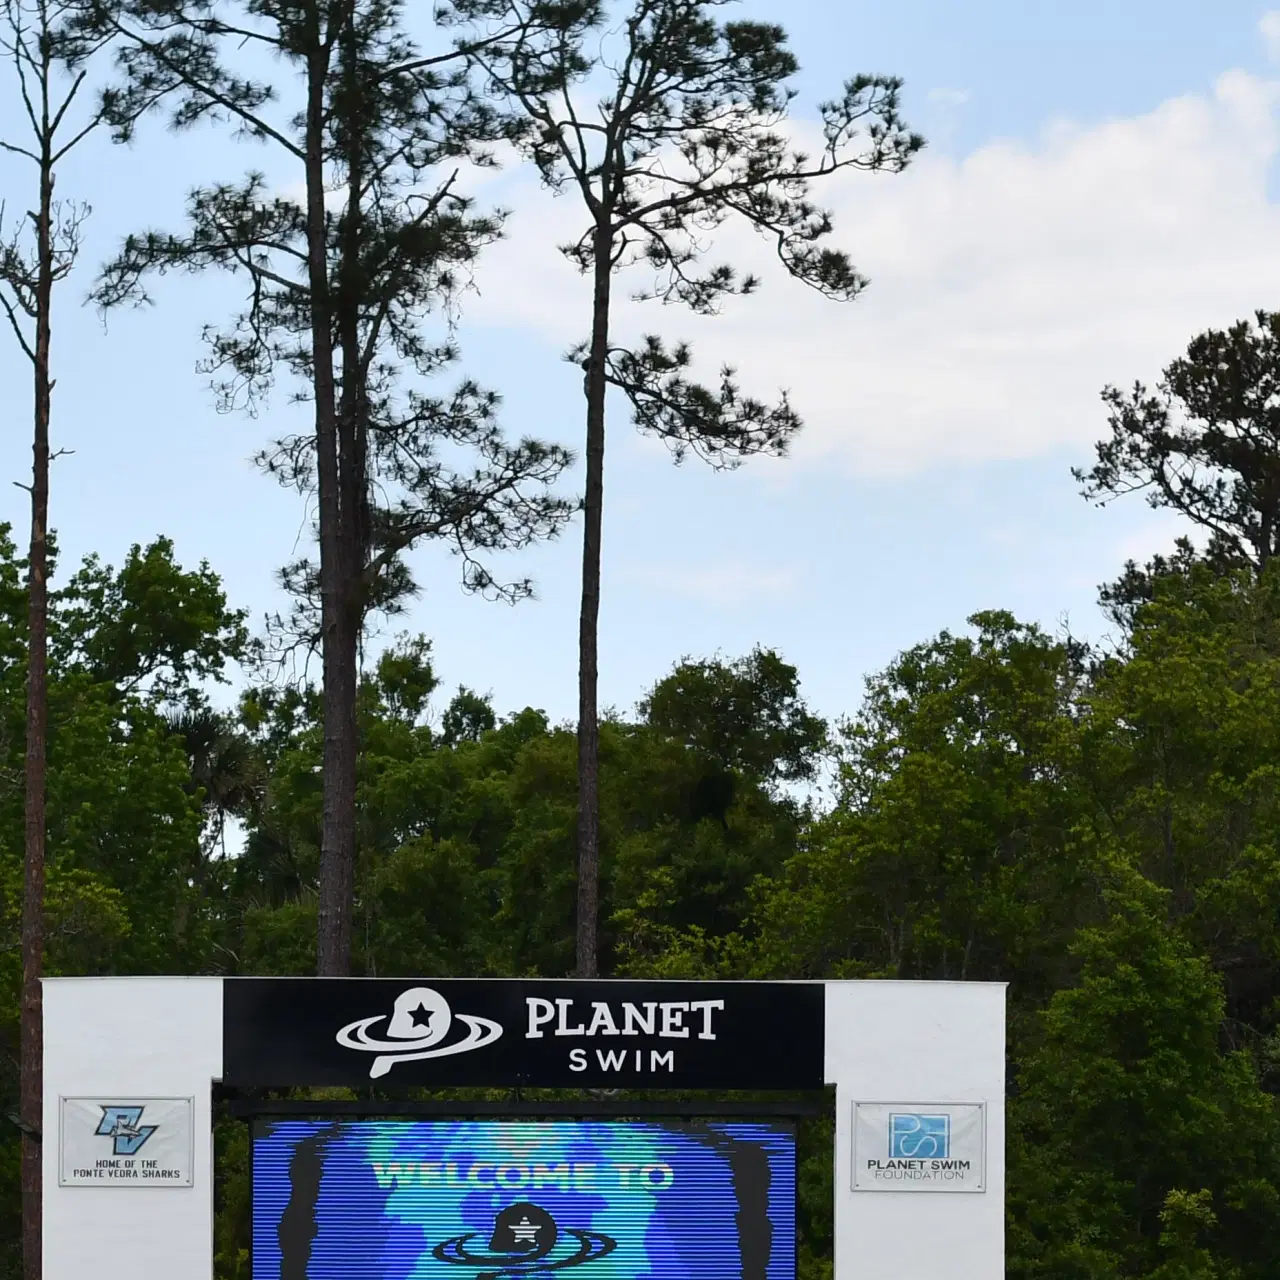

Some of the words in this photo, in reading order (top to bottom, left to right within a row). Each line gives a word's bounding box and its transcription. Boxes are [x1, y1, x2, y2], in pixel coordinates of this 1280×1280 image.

[525, 997, 725, 1041] PLANET
[568, 1048, 675, 1073] SWIM
[96, 1160, 120, 1168] HOME
[124, 1160, 136, 1168] OF
[140, 1160, 158, 1168] THE
[867, 1160, 926, 1170] PLANET
[930, 1160, 970, 1170] SWIM
[73, 1169, 105, 1178] PONTE
[108, 1169, 138, 1178] VEDRA
[142, 1169, 180, 1178] SHARKS
[371, 1162, 596, 1192] WELCOME
[612, 1162, 675, 1190] TO
[874, 1169, 964, 1180] FOUNDATION
